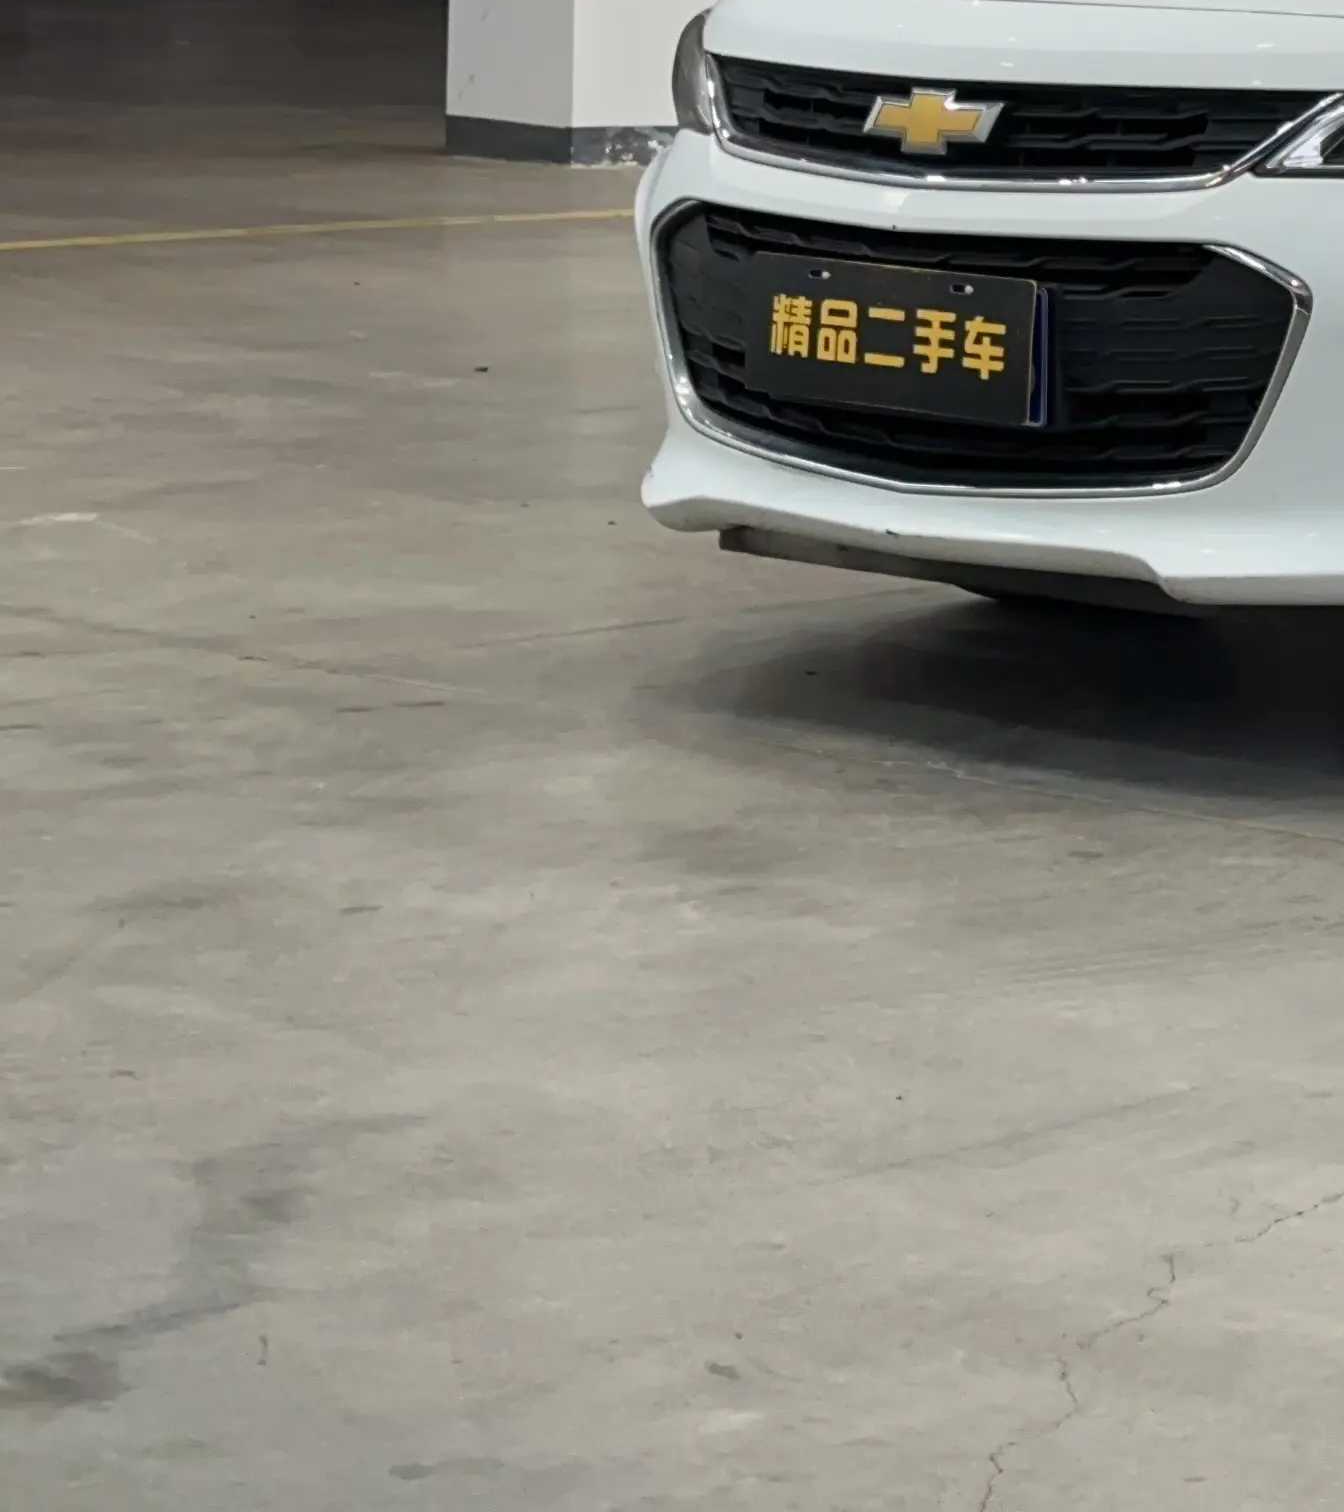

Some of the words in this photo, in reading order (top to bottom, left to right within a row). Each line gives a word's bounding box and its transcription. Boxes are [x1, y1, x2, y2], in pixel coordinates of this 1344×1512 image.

[769, 293, 1007, 380] 精品二手车
